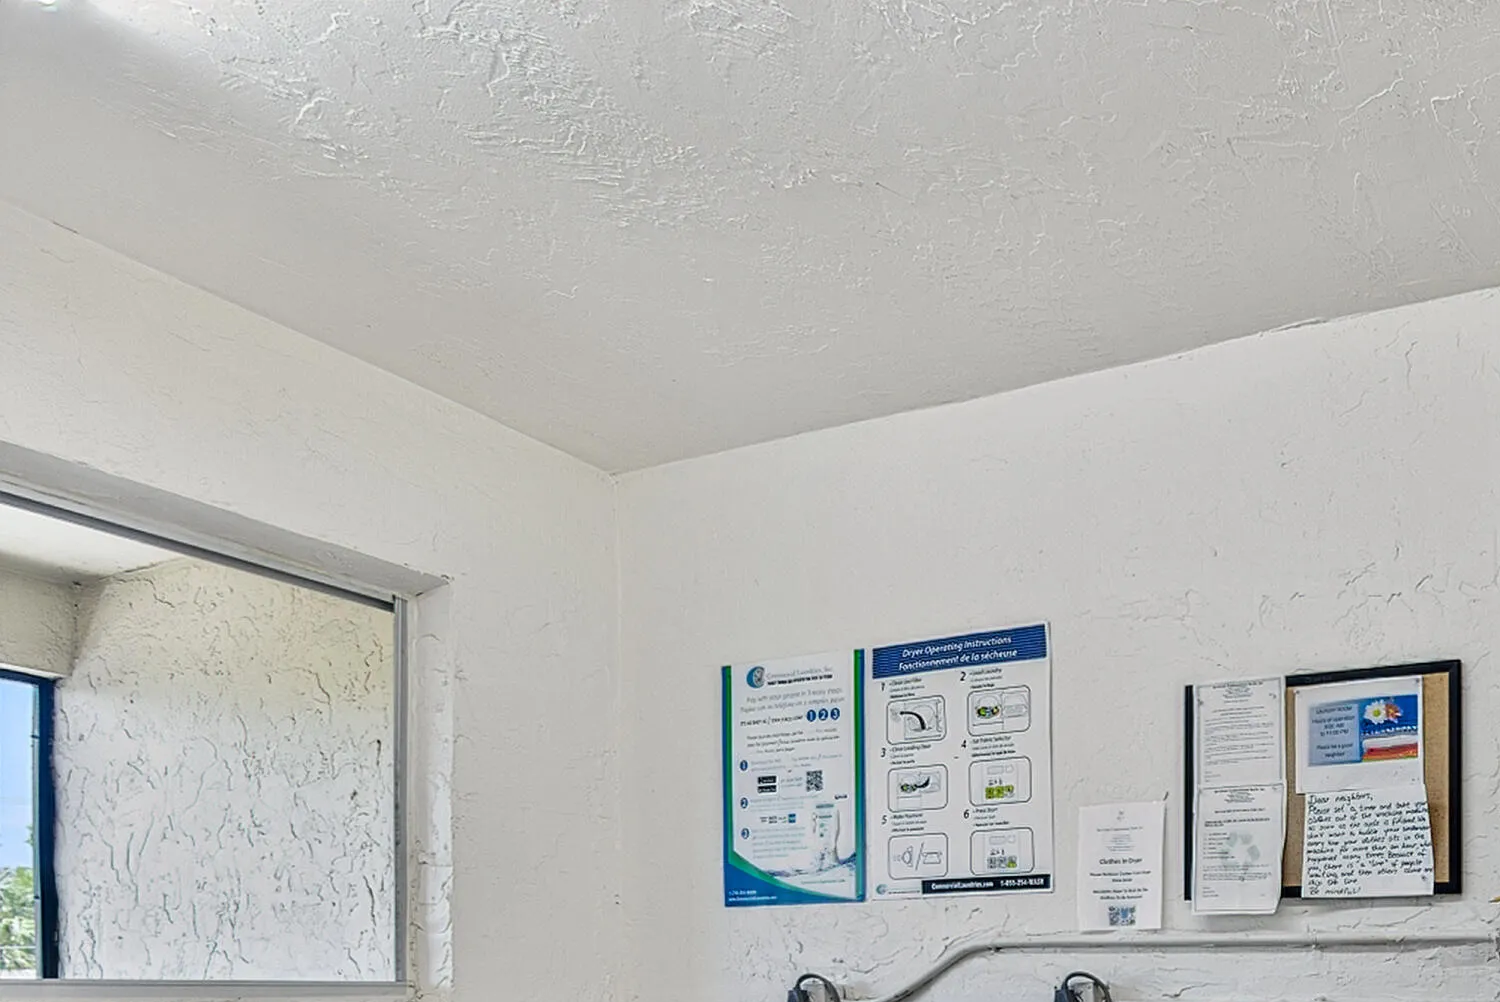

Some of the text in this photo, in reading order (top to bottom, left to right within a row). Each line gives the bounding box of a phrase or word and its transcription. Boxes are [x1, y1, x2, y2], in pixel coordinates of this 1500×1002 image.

[902, 635, 1013, 658] Dryer Operating Instructions
[899, 655, 959, 671] Fonctionnement
[960, 653, 970, 663] de
[971, 651, 979, 661] la
[960, 671, 966, 681] 2
[882, 682, 886, 690] 1
[961, 740, 967, 748] 4
[881, 747, 886, 757] 3
[963, 809, 970, 819] 6
[882, 815, 888, 825] 5
